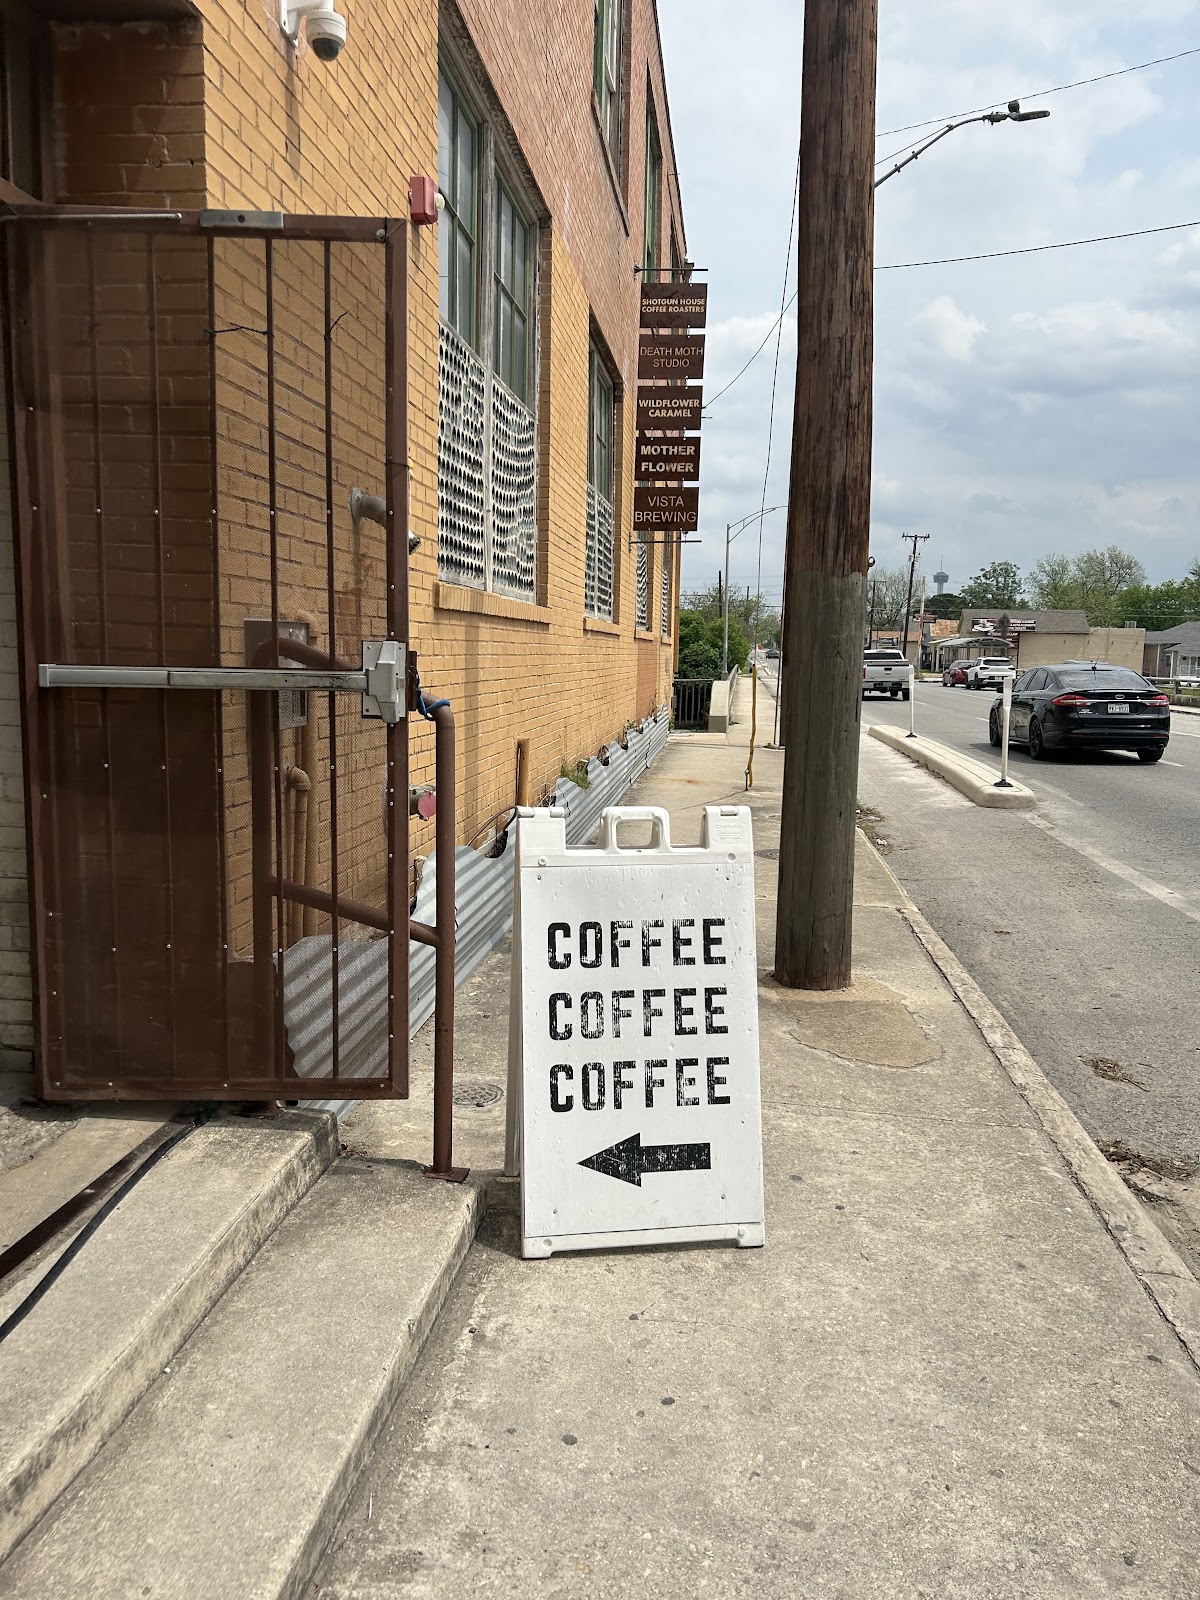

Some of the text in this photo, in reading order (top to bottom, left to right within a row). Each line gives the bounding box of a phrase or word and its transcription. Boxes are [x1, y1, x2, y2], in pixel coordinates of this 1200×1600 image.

[640, 347, 703, 356] DEATH MOTH
[653, 358, 690, 367] STUDIO
[638, 399, 700, 408] WILDFLOWER
[648, 409, 692, 418] CARAMEL
[641, 446, 695, 455] MOTHER
[641, 462, 694, 472] FLOWER
[648, 496, 684, 506] VISTA
[635, 512, 696, 522] BREWING
[547, 918, 727, 969] COFFEE
[548, 986, 729, 1041] COFFEE
[549, 1056, 731, 1113] COFFEE
